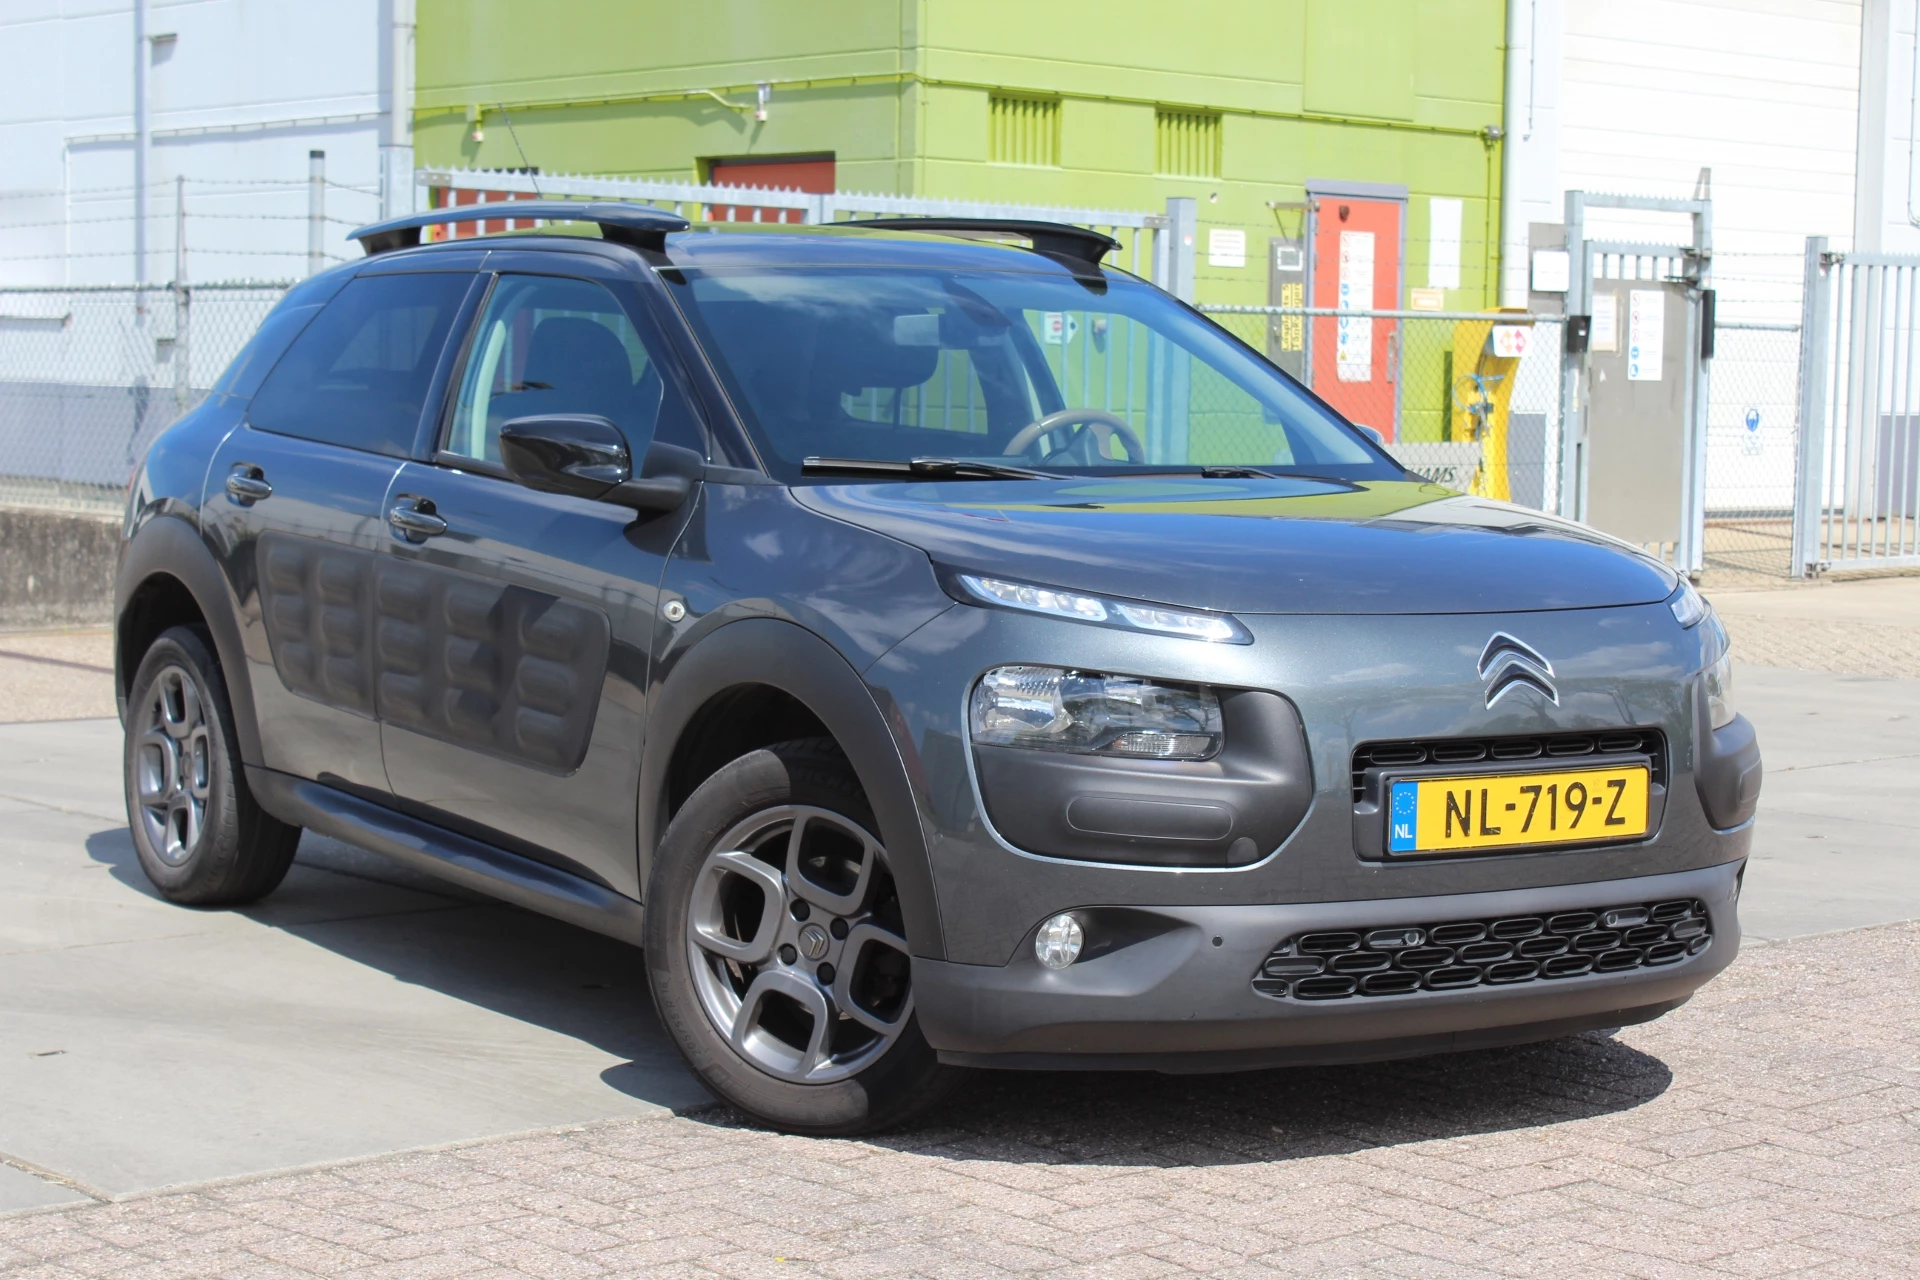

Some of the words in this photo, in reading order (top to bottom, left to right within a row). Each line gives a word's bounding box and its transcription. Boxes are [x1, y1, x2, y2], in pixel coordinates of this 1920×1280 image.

[1282, 296, 1291, 351] Losplats
[1394, 823, 1413, 839] NL
[1445, 779, 1626, 838] NL-719-Z
